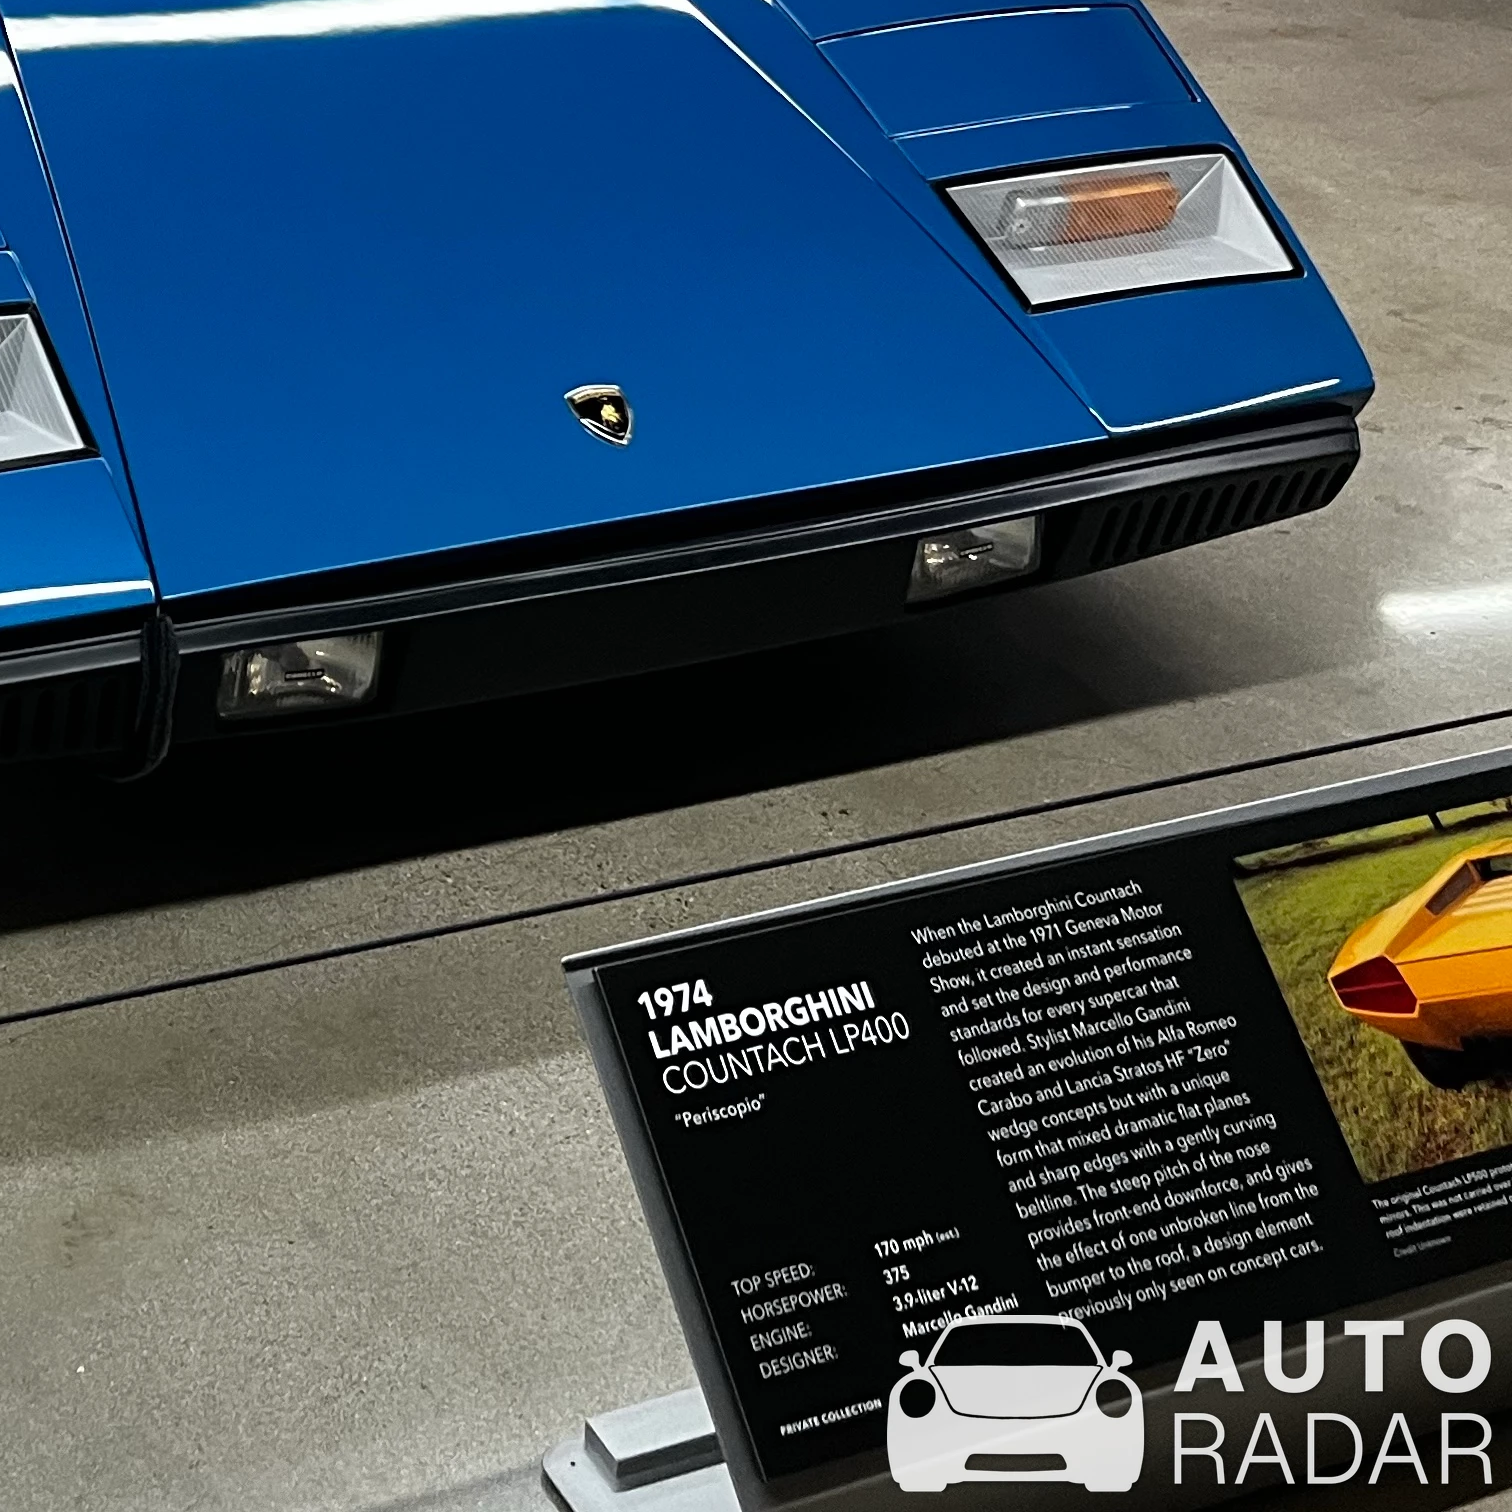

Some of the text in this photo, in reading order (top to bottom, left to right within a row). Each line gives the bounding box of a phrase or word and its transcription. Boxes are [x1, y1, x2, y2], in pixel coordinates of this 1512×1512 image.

[911, 880, 1142, 943] When the Lamborghini Countach
[923, 904, 1162, 967] debuted at the 1971 Geneva Motor
[930, 926, 1182, 992] Show, it created an instant sensation
[941, 949, 1192, 1016] and set the design and performance
[638, 979, 713, 1018] 1974
[648, 981, 875, 1058] LAMBORGHINI
[950, 976, 1180, 1041] standards for every supercar that
[663, 1012, 909, 1093] COUNTACH LP400
[958, 998, 1191, 1065] followed. Stylist Marcello Gandini
[969, 1016, 1236, 1090] created an evolution of his Alfa Romeo
[978, 1092, 1032, 1114] Carabo
[1036, 1081, 1063, 1101] and
[1065, 1071, 1112, 1093] Lancia
[1113, 1061, 1164, 1081] Stratos
[1164, 1050, 1184, 1068] HF
[988, 1071, 1230, 1140] wedge concepts but with a unique
[997, 1093, 1250, 1166] form that mixed dramatic flat planes
[1009, 1114, 1276, 1191] and sharp edges with a gently curving
[1016, 1142, 1270, 1217] beltline. The steep pitch of the nose
[1028, 1158, 1312, 1248] provides front-end downforce, and gives
[875, 1239, 899, 1257] 170
[903, 1230, 934, 1250] mph
[1037, 1183, 1318, 1270] the effect of one unbroken line from the
[1046, 1212, 1313, 1296] bumper to the roof, a design element
[731, 1263, 815, 1295] TOP SPEED:
[741, 1284, 847, 1322] HORSEPOWER:
[883, 1265, 909, 1284] 375
[893, 1275, 979, 1310] 3.9-liter V-12
[1059, 1240, 1323, 1329] previously only seen on concept cars.
[750, 1322, 811, 1350] ENGINE:
[902, 1293, 1019, 1339] Marcello Gandini
[759, 1345, 838, 1377] DESIGNER:
[780, 1399, 882, 1435] PRIVATE COLLECTION
